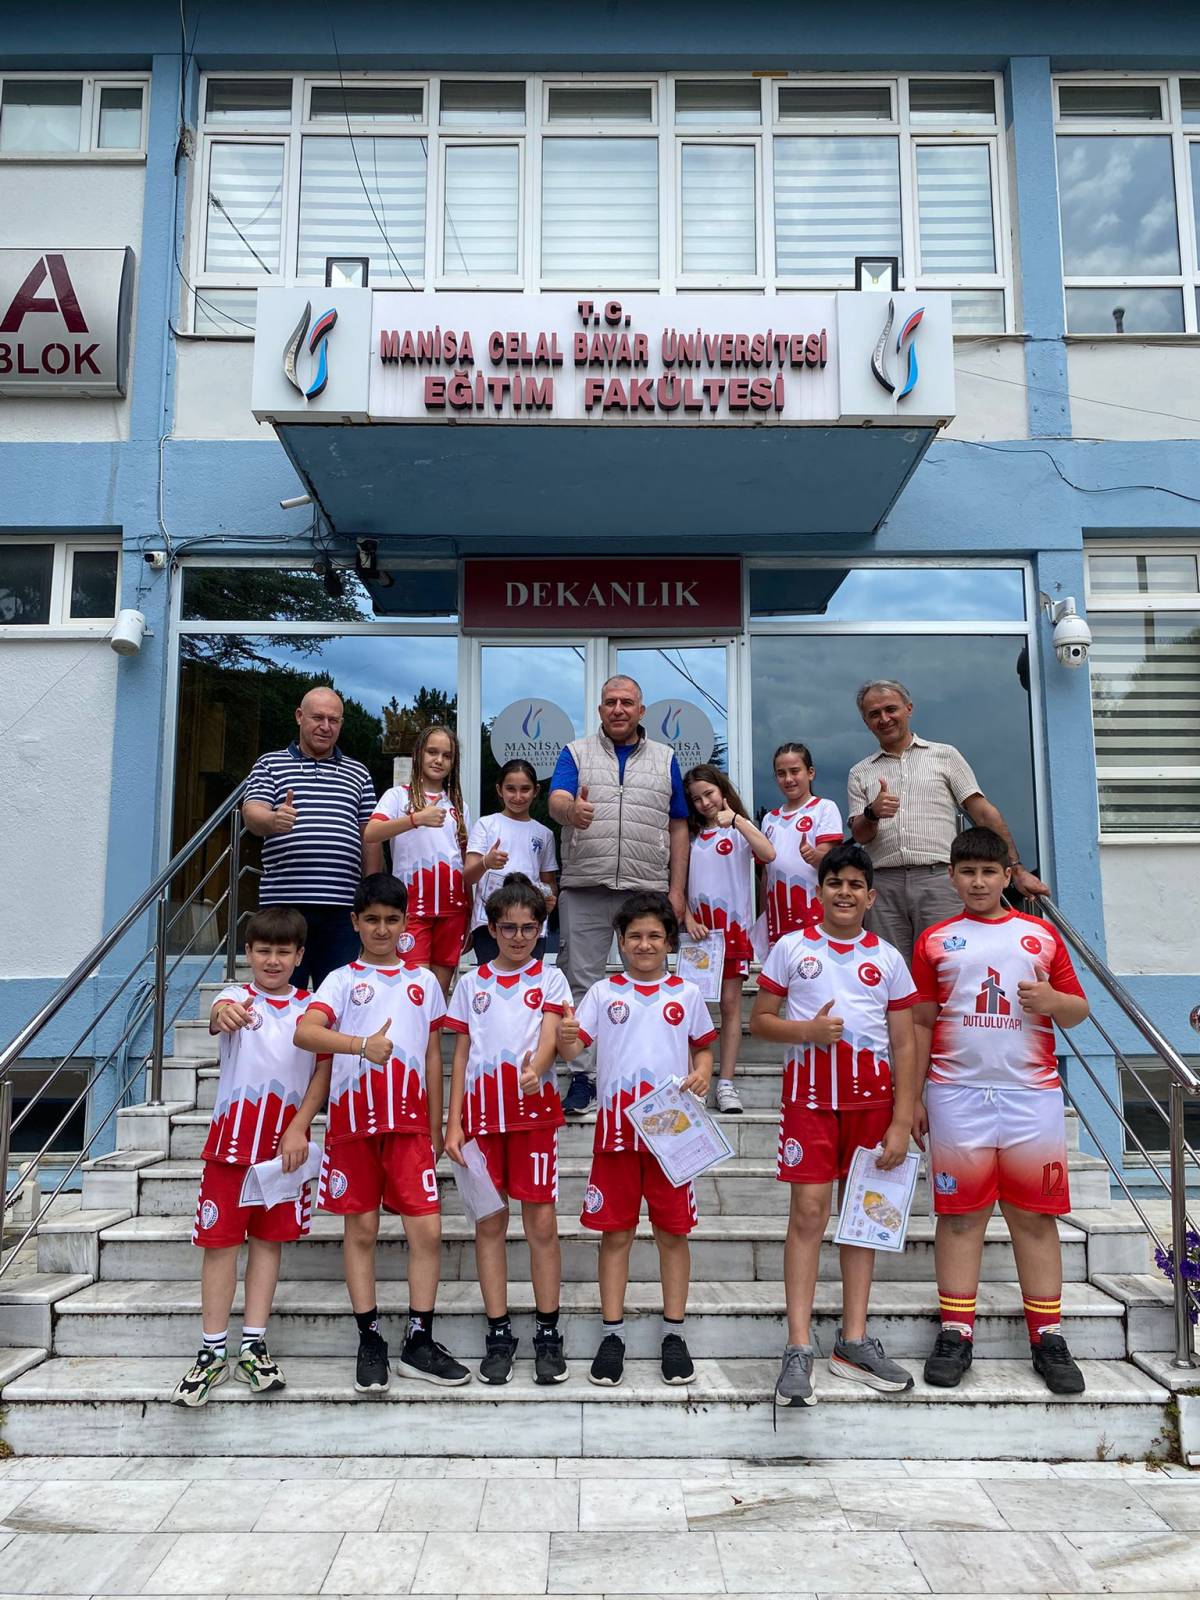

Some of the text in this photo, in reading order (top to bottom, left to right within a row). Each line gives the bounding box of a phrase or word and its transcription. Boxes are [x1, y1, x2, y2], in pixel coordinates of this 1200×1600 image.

[0, 254, 89, 333] A
[578, 301, 631, 326] T.C.
[0, 343, 101, 375] BLOK
[380, 325, 474, 365] MANİSA
[488, 331, 563, 366] CELAL
[574, 332, 649, 367] BAYAR
[662, 328, 828, 368] ÜNİVERSİTESİ
[424, 369, 785, 412] EĞİTİM FAKÜLTESİ
[505, 582, 699, 607] DEKANLIK
[667, 740, 701, 751] NİSA
[422, 1168, 438, 1202] 9
[530, 1152, 549, 1186] 11
[1041, 1161, 1064, 1197] 12
